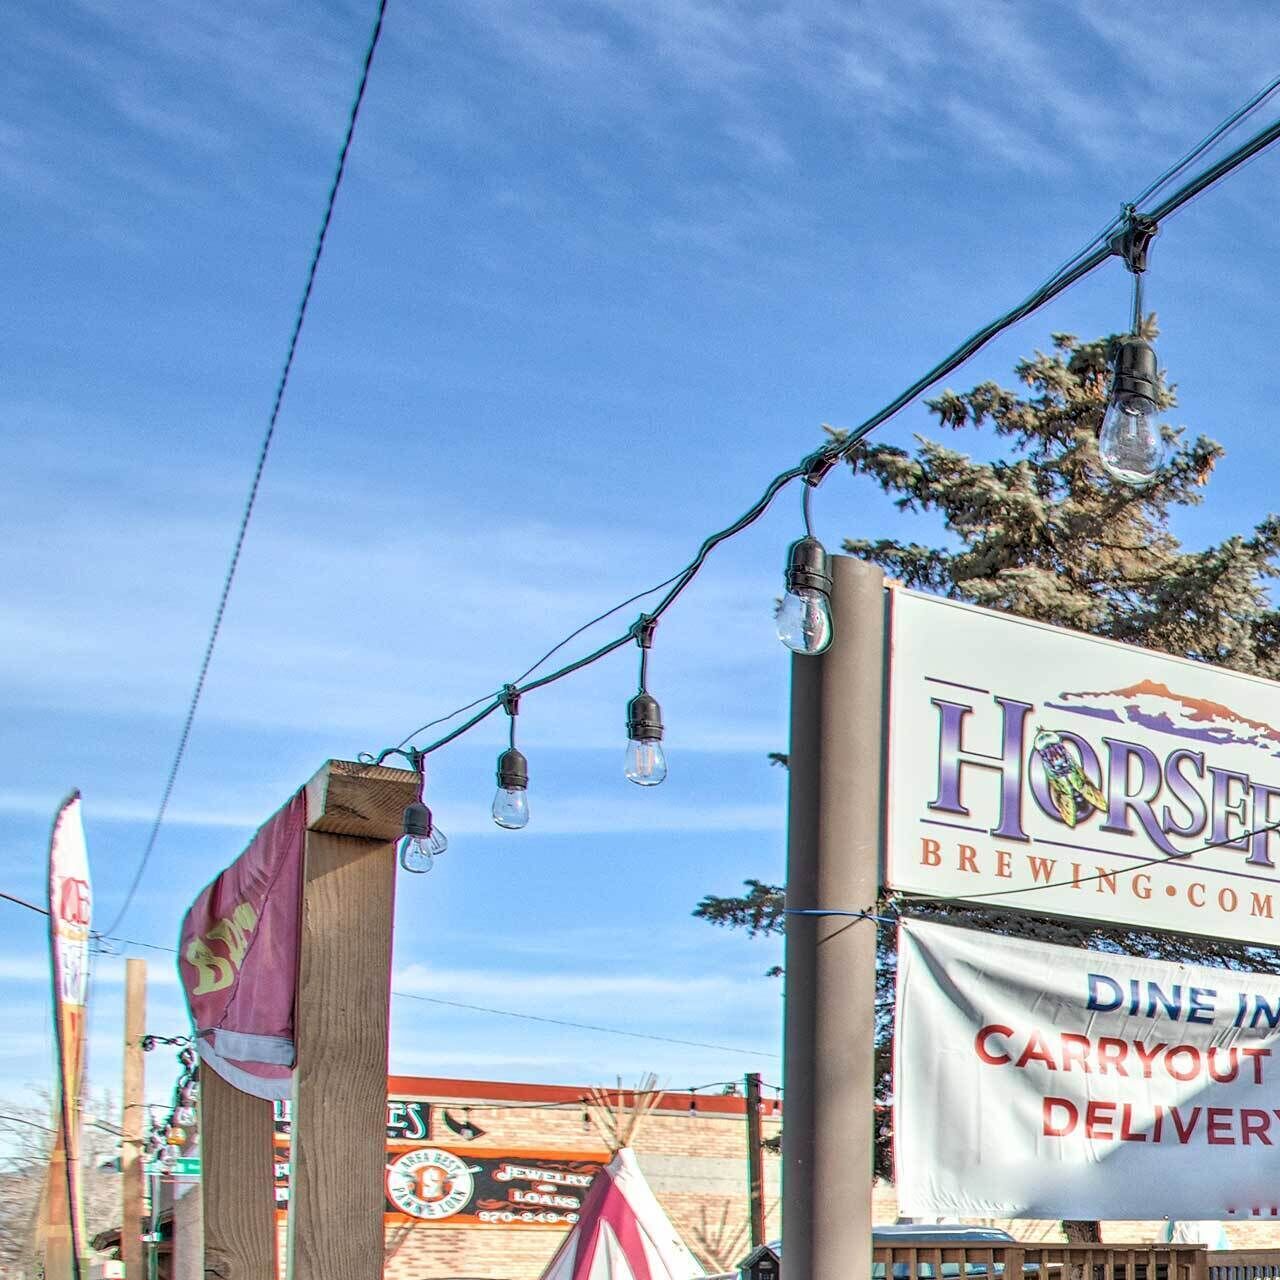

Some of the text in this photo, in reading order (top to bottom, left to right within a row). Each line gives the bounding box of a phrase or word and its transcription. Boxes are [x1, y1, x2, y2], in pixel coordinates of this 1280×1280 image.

[919, 837, 1153, 901] BREWING
[1086, 973, 1215, 1026] DINE
[974, 1024, 1272, 1086] CARRYOUT
[495, 1163, 594, 1187] JEWELRY
[511, 1189, 580, 1209] LOANS
